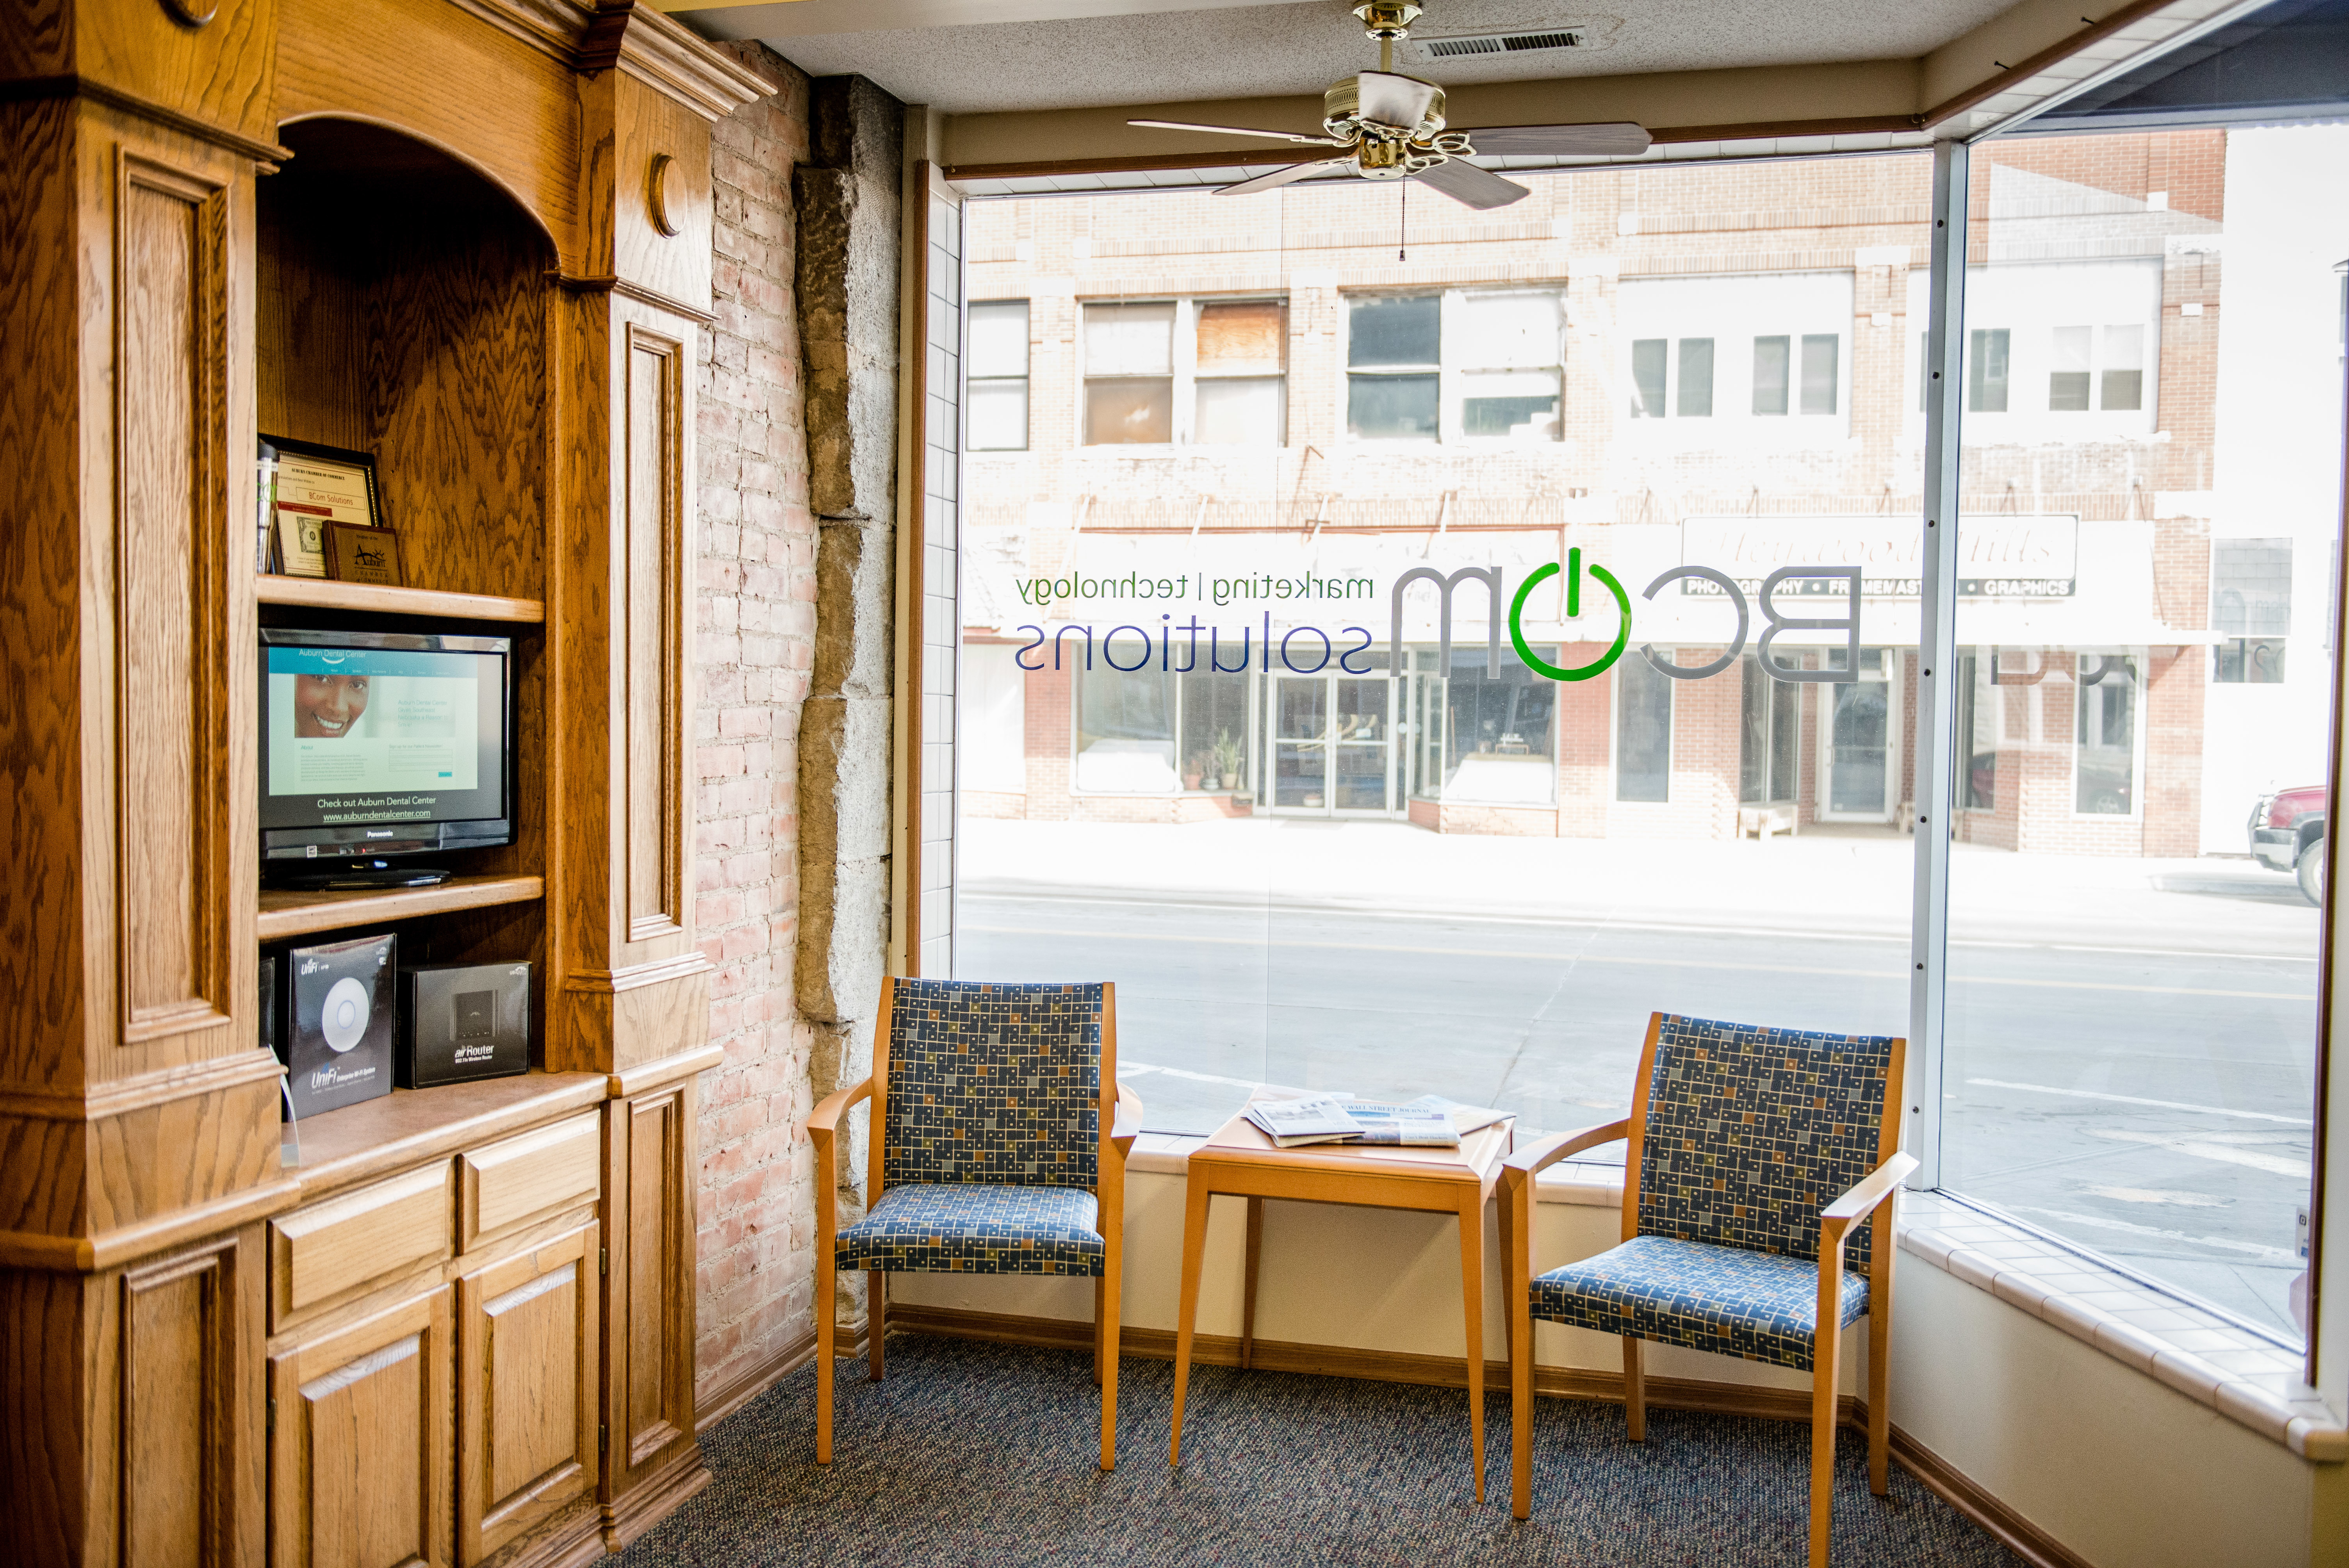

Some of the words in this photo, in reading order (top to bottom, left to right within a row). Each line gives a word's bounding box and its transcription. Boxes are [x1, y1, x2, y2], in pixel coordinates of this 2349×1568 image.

[309, 492, 326, 501] BCom
[327, 494, 353, 505] Solutions
[355, 543, 386, 567] Auburn
[1687, 579, 1804, 594] PHOGRPHY
[1984, 579, 2069, 595] GRAPHICS
[299, 648, 322, 656] Auburn
[346, 650, 366, 658] Center
[317, 798, 342, 808] Check
[358, 797, 385, 807] Auburn
[387, 796, 410, 805] Dental
[412, 796, 436, 804] Center
[323, 809, 431, 821] www.auburndentalcenter.com
[301, 962, 318, 975] UniFi
[312, 1067, 337, 1089] UniFi
